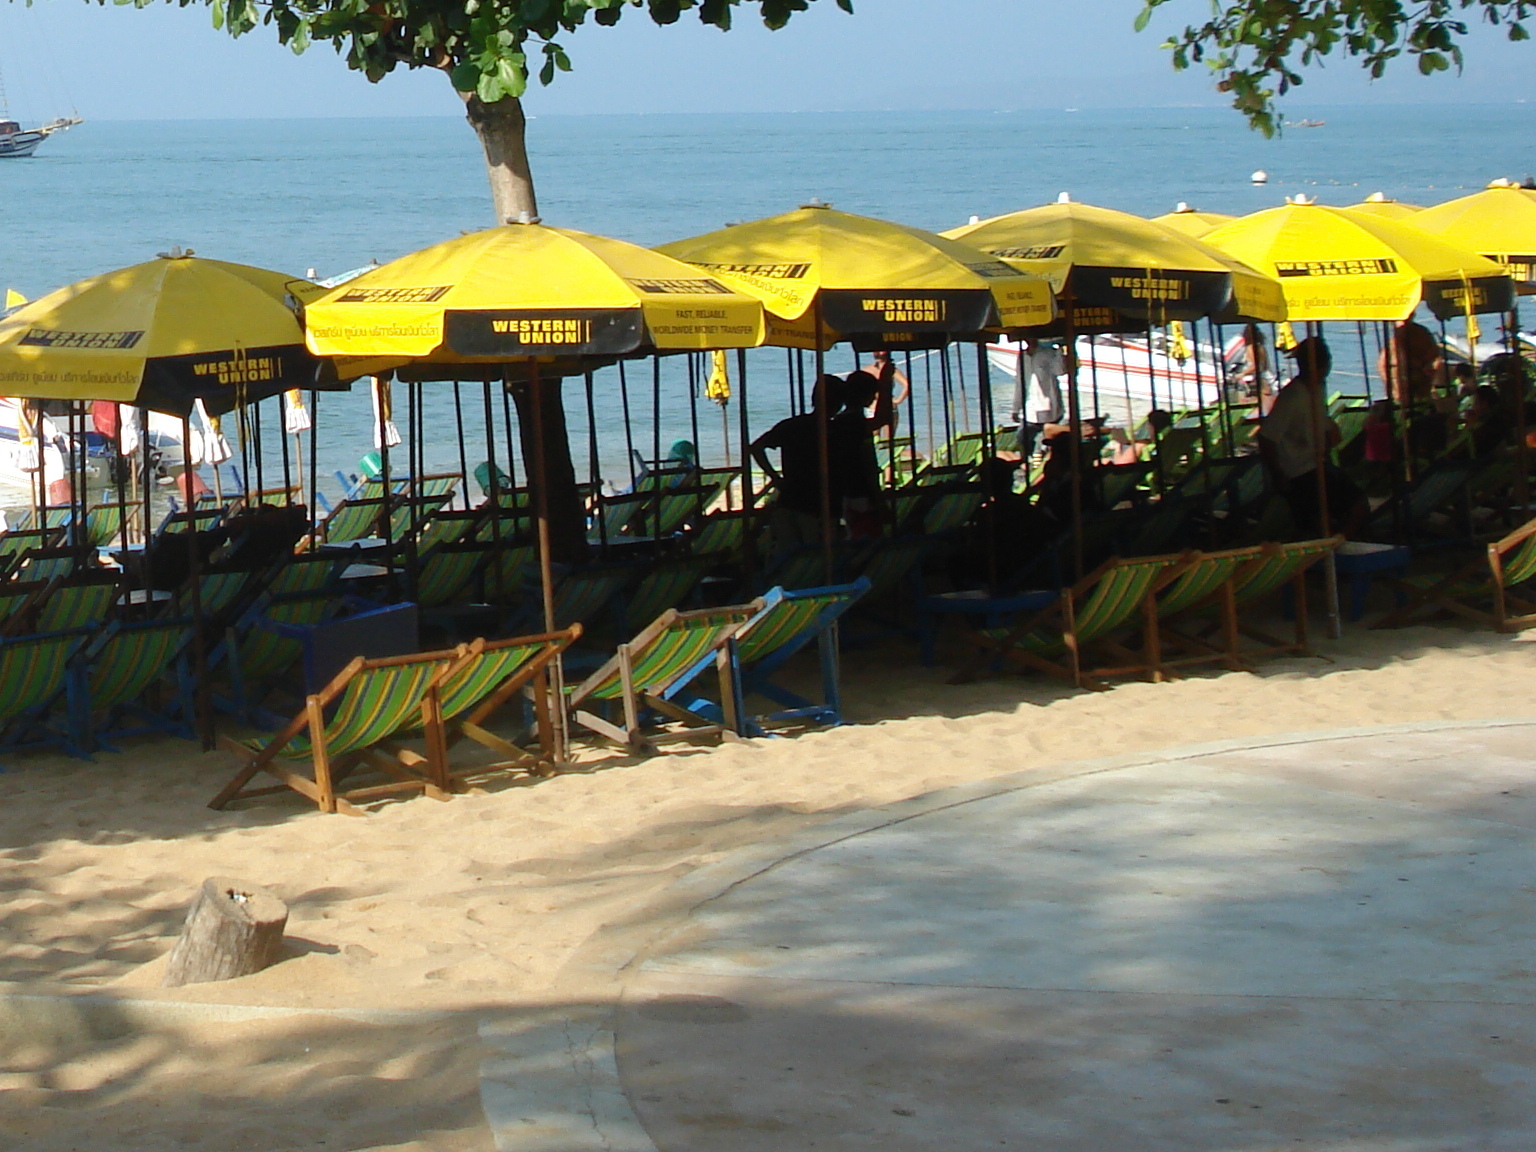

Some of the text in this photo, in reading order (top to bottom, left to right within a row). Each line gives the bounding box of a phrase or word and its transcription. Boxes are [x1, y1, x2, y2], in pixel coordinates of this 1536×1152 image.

[1275, 260, 1376, 271] WESTERN
[1309, 267, 1379, 276] UNION
[1110, 277, 1179, 290] WESTERN
[346, 287, 433, 297] WESTERN
[1131, 289, 1179, 300] UNION
[362, 295, 428, 303] UNION
[862, 300, 935, 311] WESTERN
[885, 311, 935, 322] UNION
[492, 320, 577, 332] WESTERN
[653, 325, 754, 335] WORLDWIDE MONEY TRANSFER
[28, 329, 124, 341] WESTERN
[519, 332, 577, 344] UNION
[49, 339, 120, 348] UNION
[193, 357, 271, 375] WESTERN
[219, 369, 271, 385] UNION
